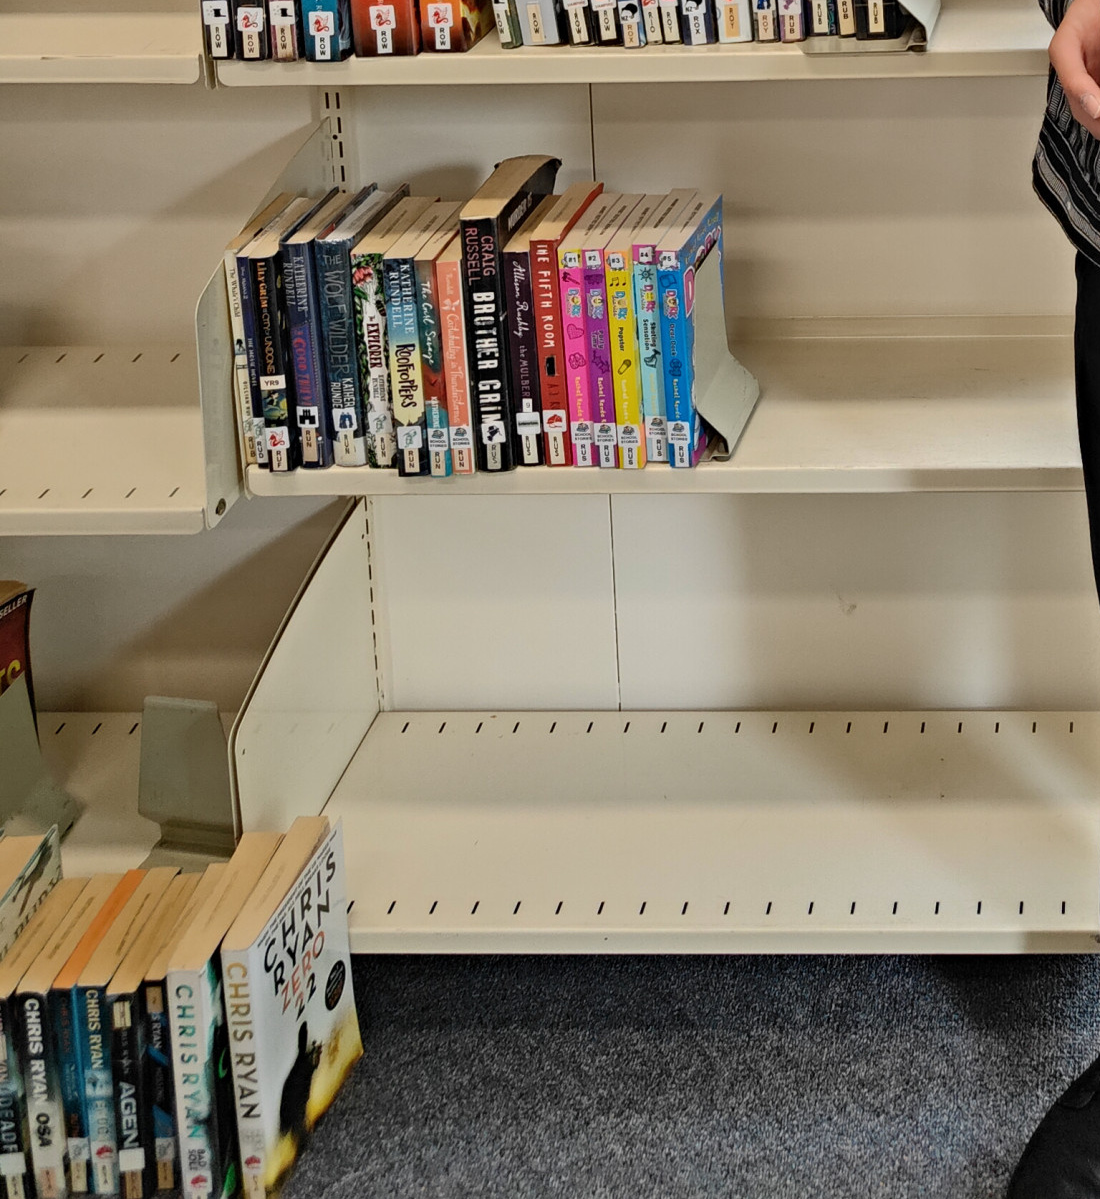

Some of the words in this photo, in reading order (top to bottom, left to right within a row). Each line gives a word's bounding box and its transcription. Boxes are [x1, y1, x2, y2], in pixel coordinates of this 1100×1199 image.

[465, 227, 480, 286] RUSSELL
[481, 236, 495, 276] CRAIG
[537, 245, 549, 262] THE
[284, 263, 294, 306] RUNDELL
[293, 257, 307, 312] KATHERINE
[390, 272, 402, 328] RUNDELL
[401, 264, 414, 333] KATHERINE
[540, 271, 552, 308] FIFTH
[367, 323, 382, 368] EXPLORER
[473, 292, 498, 369] BROTHER
[543, 316, 554, 348] ROOM
[265, 851, 336, 972] CHRIS
[273, 894, 329, 994] RYAN
[280, 932, 324, 1012] ZERO
[25, 999, 41, 1054] CHRIS
[86, 989, 98, 1030] CHRIS
[175, 985, 195, 1063] CHRIS
[227, 963, 249, 1042] CHRIS
[89, 1035, 103, 1069] RYAN
[30, 1060, 47, 1104] RYAN
[183, 1074, 203, 1138] RYAN
[236, 1053, 261, 1118] RYAN
